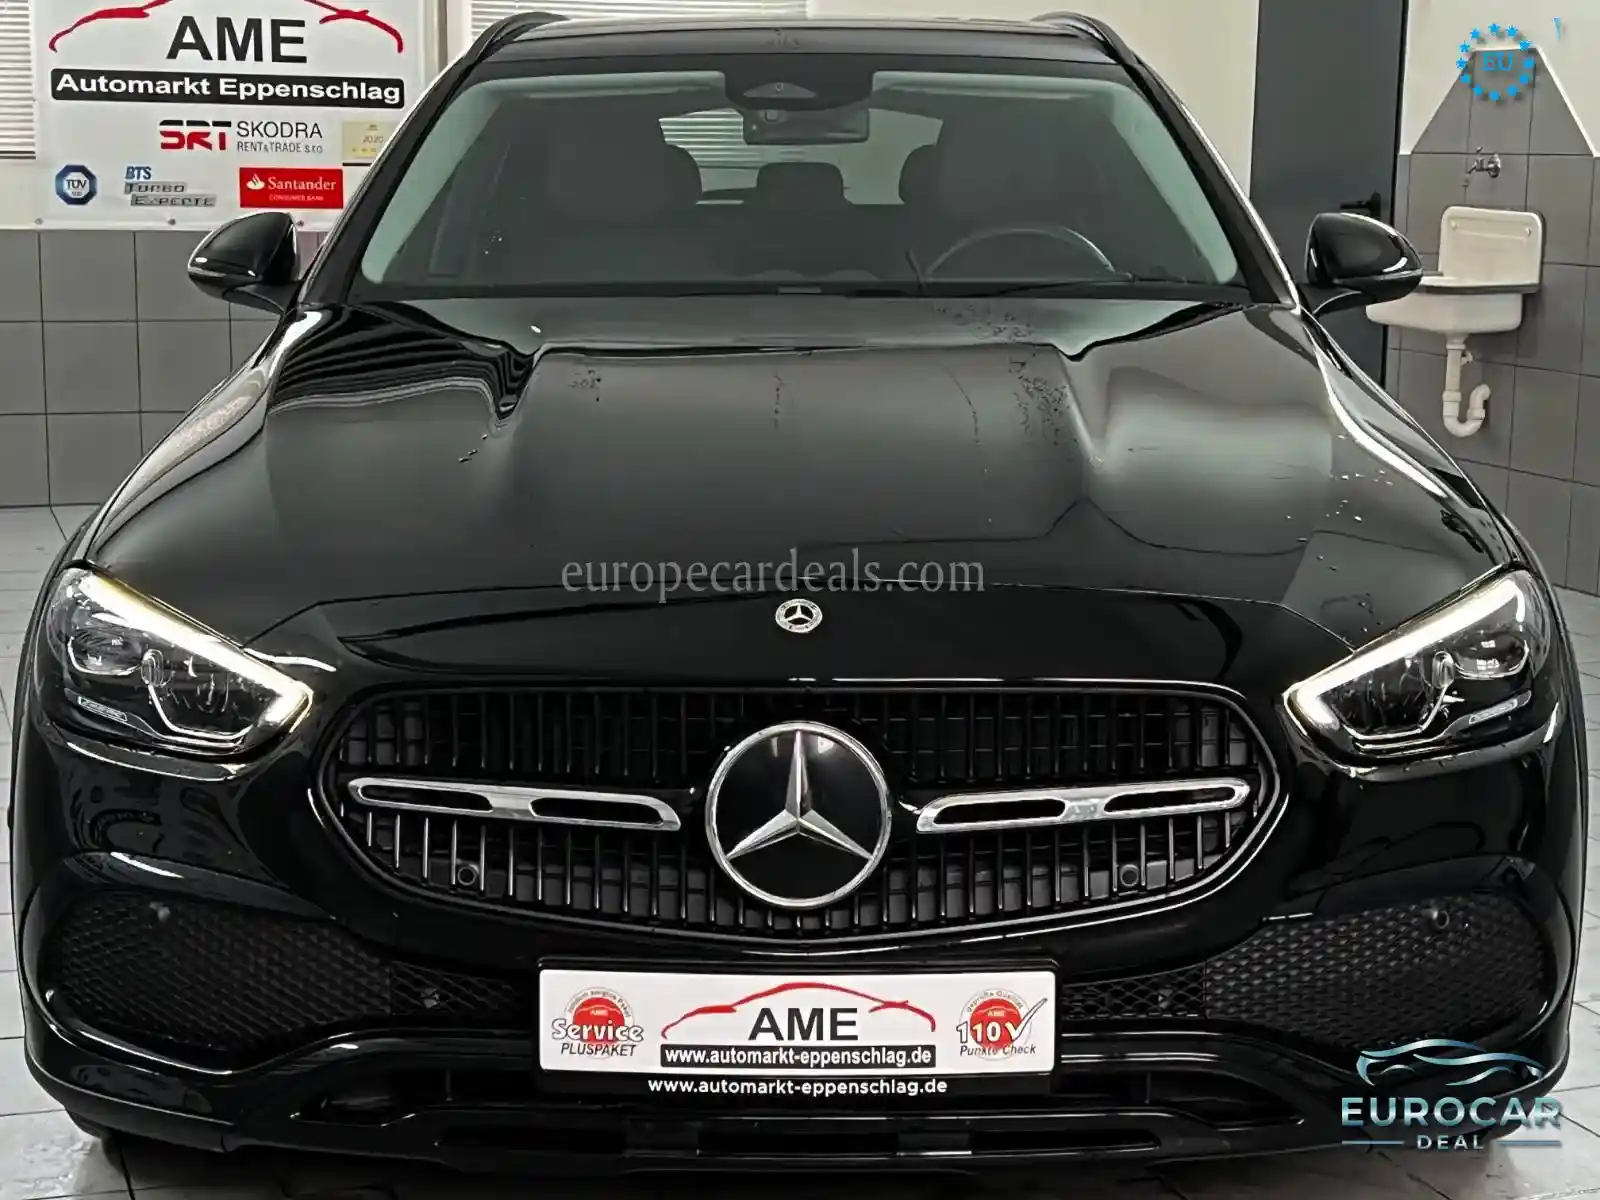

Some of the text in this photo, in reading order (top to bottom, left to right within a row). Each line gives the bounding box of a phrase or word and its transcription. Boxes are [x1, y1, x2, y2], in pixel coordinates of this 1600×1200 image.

[166, 15, 308, 64] AME
[56, 73, 401, 105] Automarkt Eppenschlag
[159, 119, 232, 151] SRT
[236, 120, 323, 139] SKODRA
[125, 166, 152, 180] BTS
[267, 176, 337, 191] Santander
[551, 1017, 645, 1043] Service
[748, 1007, 859, 1041] AME
[560, 1042, 638, 1057] PLUSPAKET
[665, 1047, 933, 1069] www.automarkt-eppenschlag.de
[647, 1079, 949, 1097] www.automarkt-eppenschlag.de
